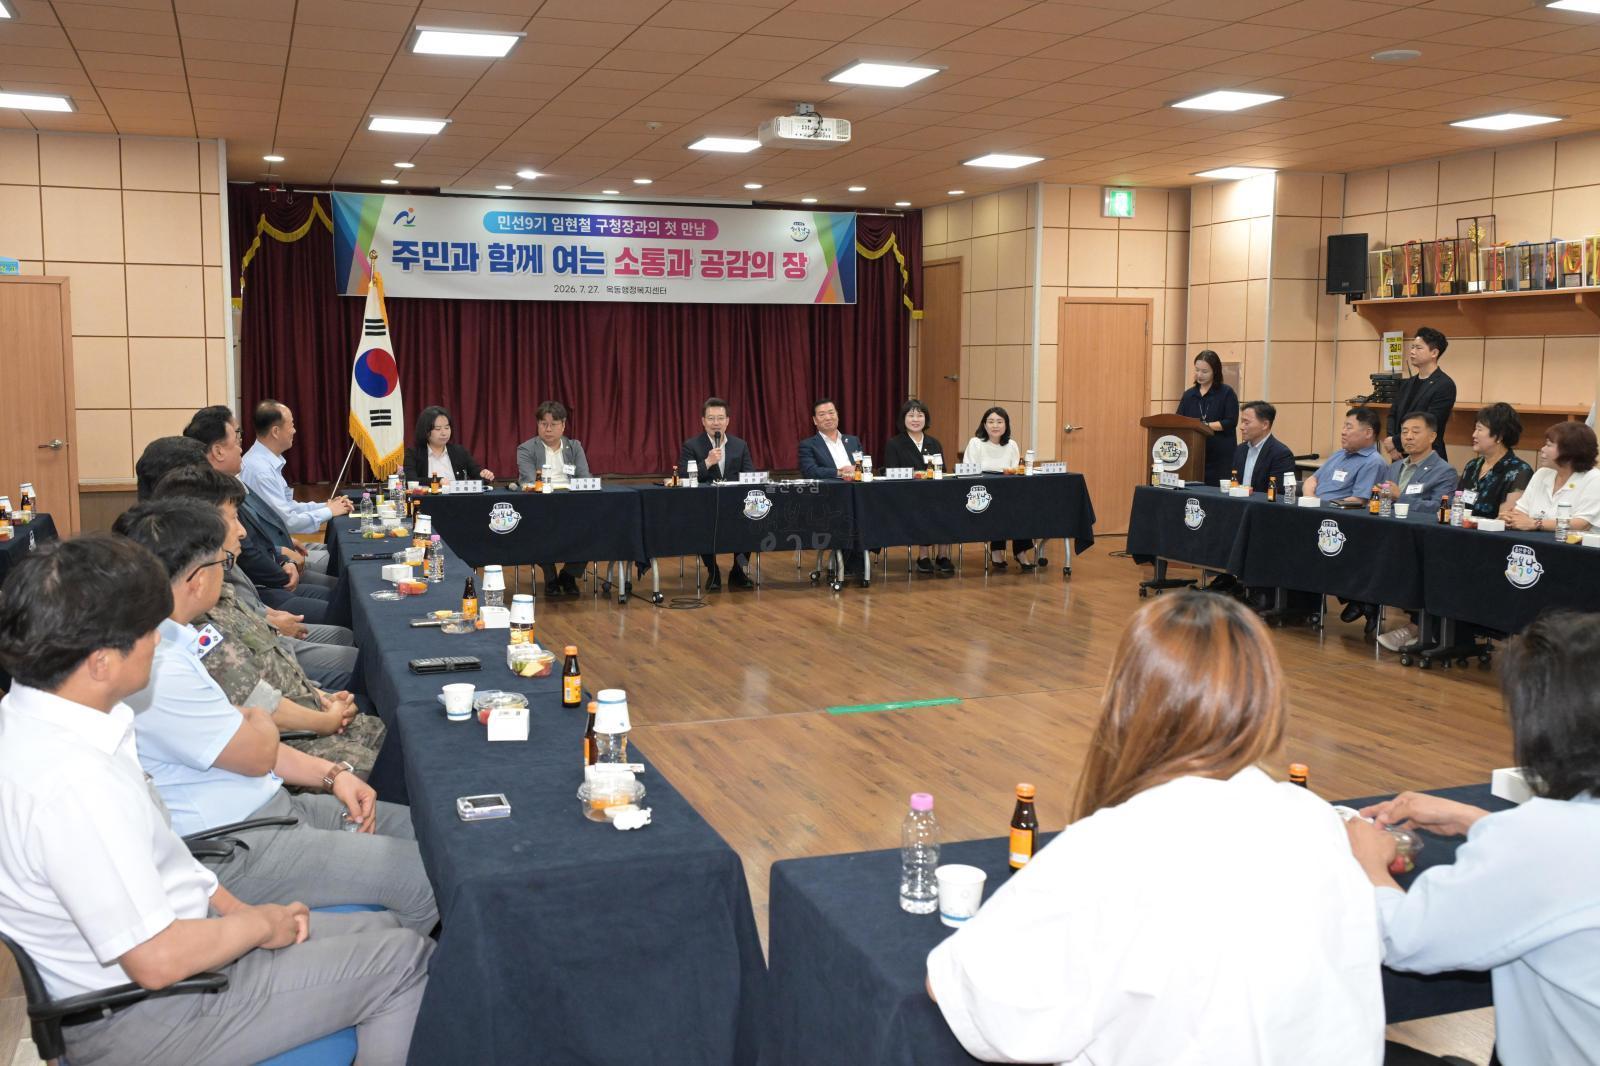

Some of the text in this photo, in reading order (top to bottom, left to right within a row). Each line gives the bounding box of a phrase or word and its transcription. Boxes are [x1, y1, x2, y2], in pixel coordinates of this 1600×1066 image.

[497, 214, 707, 237] 민선9기 임현철 구청장과의 첫 만남
[391, 240, 809, 280] 주민과 함께 여는 소통과 공감의 장
[553, 284, 577, 294] 2026.
[587, 285, 600, 295] 27.
[605, 285, 668, 296] 옥동행정복지센터
